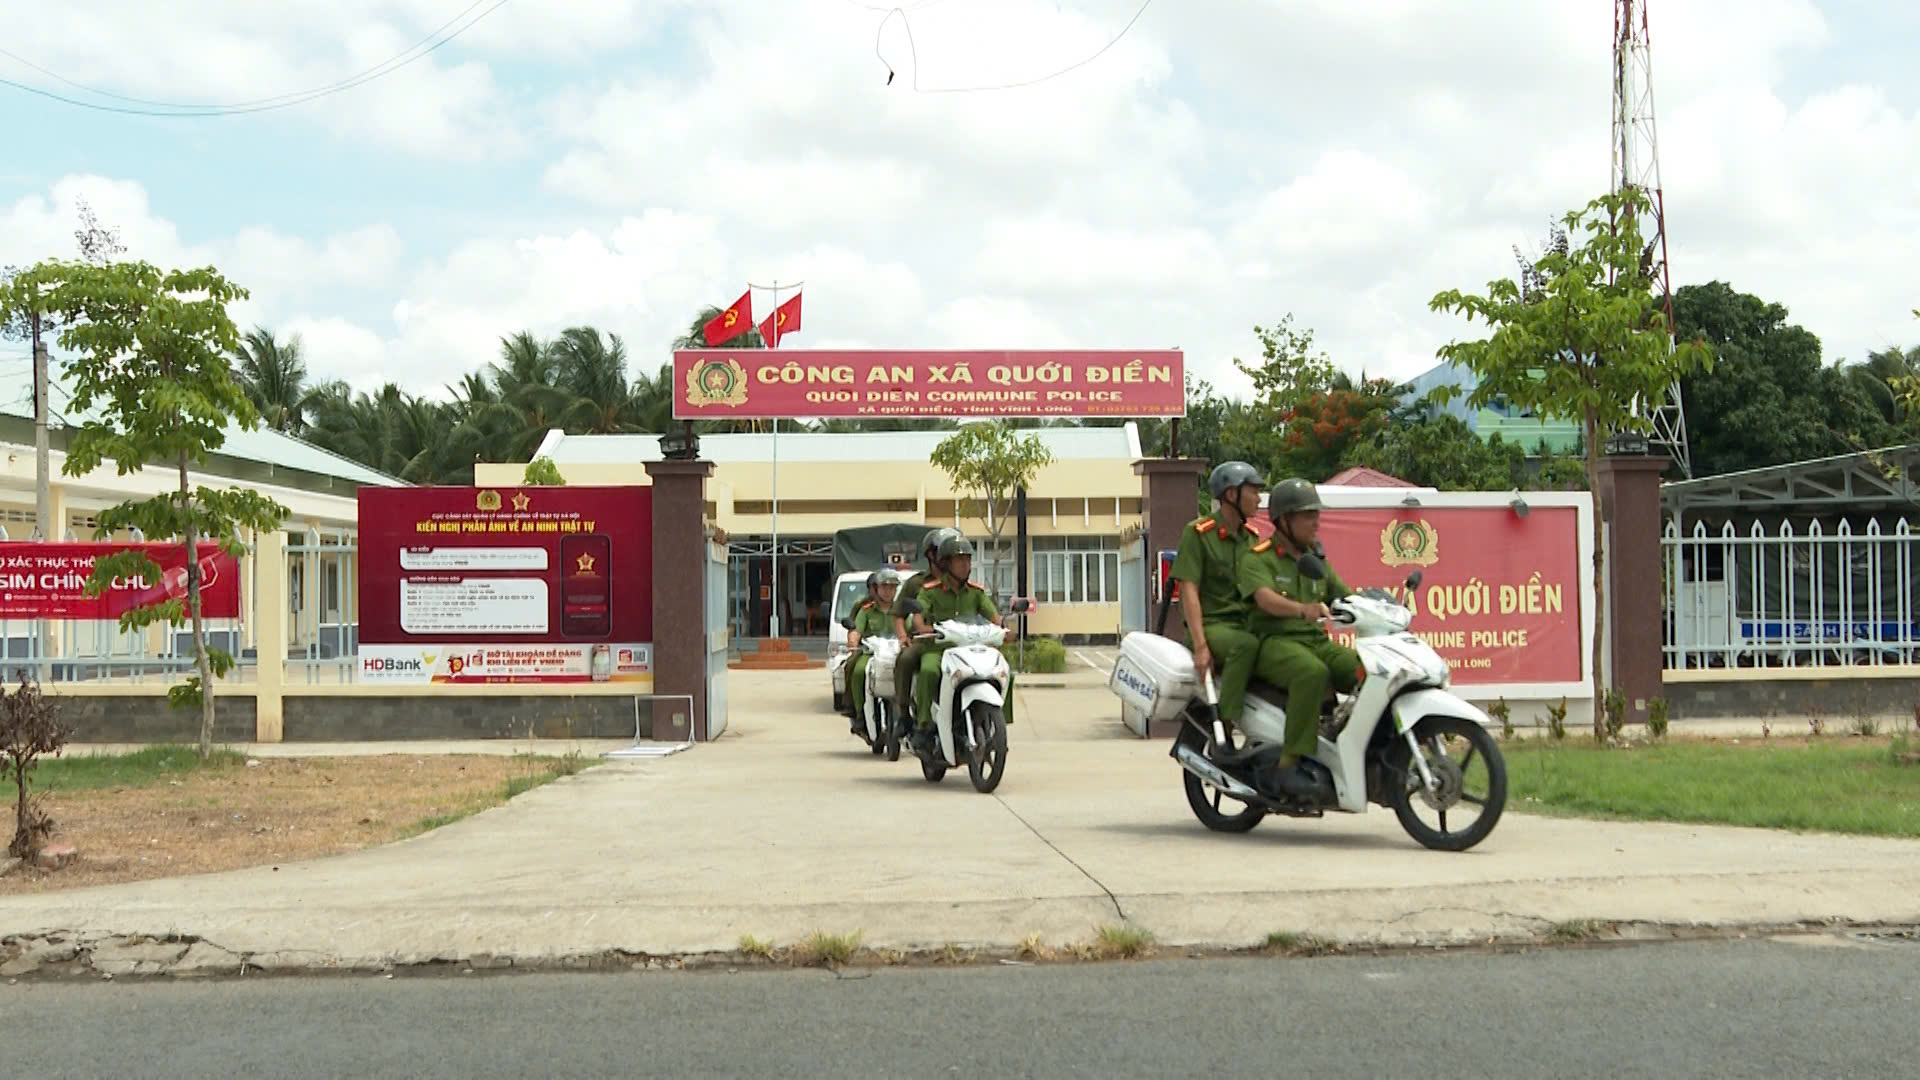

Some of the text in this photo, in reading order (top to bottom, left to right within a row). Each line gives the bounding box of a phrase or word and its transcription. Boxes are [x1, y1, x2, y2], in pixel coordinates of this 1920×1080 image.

[757, 359, 1171, 386] CÔNG AN XÃ QUỚI ĐIỀN
[926, 390, 1038, 403] COMMUNE
[1046, 390, 1123, 403] POLICE
[1036, 404, 1073, 413] LONG
[416, 519, 438, 532] KIẾN
[439, 521, 460, 534] NGHỊ
[462, 519, 487, 532] PHẢN
[508, 519, 519, 532] VỀ
[521, 521, 535, 532] AN
[536, 521, 558, 532] NINH
[560, 519, 581, 533] TRẬT
[583, 521, 595, 533] TỰ
[7, 555, 33, 568] XÁC
[35, 557, 69, 569] THỰC
[40, 569, 90, 590] CHÍN
[1427, 576, 1491, 621] QUỚI
[1499, 571, 1563, 615] ĐIỀN
[1471, 629, 1528, 648] POLICE
[363, 658, 421, 670] HDBank
[1464, 658, 1492, 668] LONG
